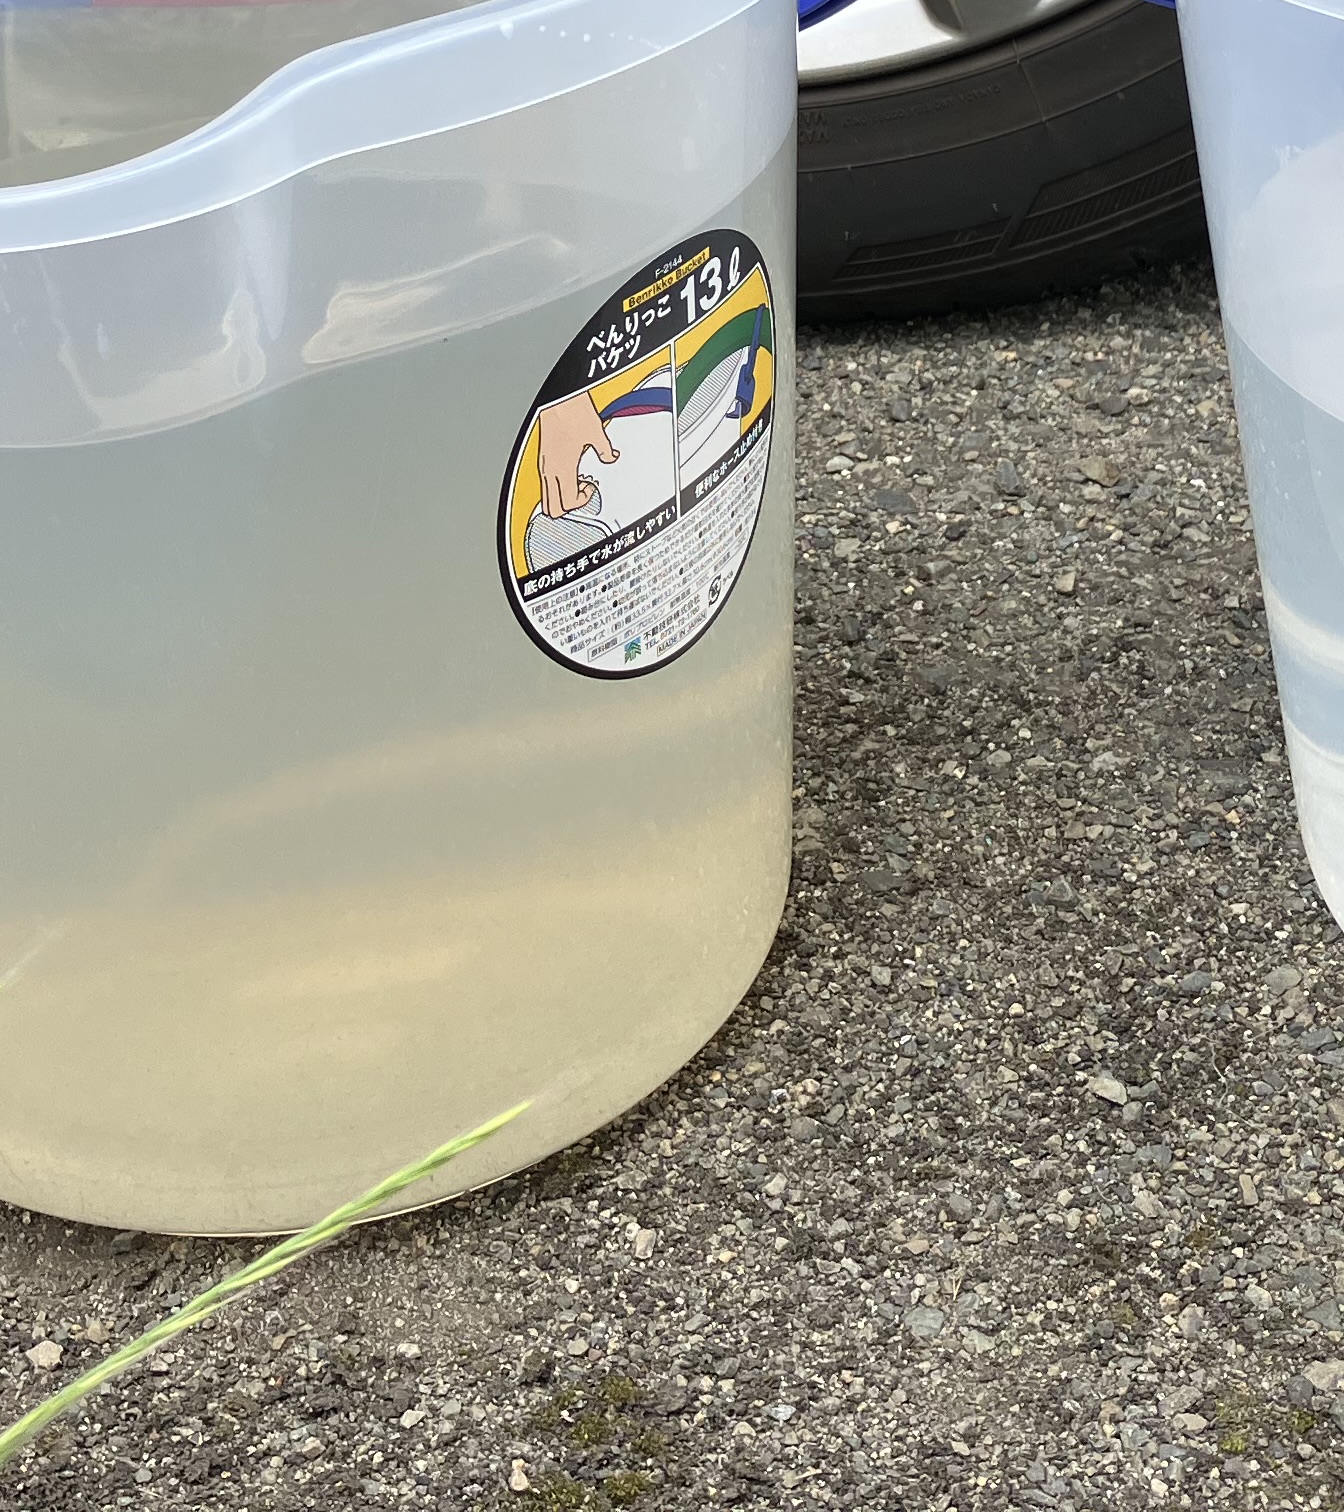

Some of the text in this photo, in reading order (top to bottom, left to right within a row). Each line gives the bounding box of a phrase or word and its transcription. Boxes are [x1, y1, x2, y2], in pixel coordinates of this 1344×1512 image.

[628, 251, 709, 308] Benrikko Bucket
[586, 298, 673, 354] べんりっこ
[587, 334, 642, 378] バケツ
[523, 505, 677, 596] 底の持ち手で水が流しやすい
